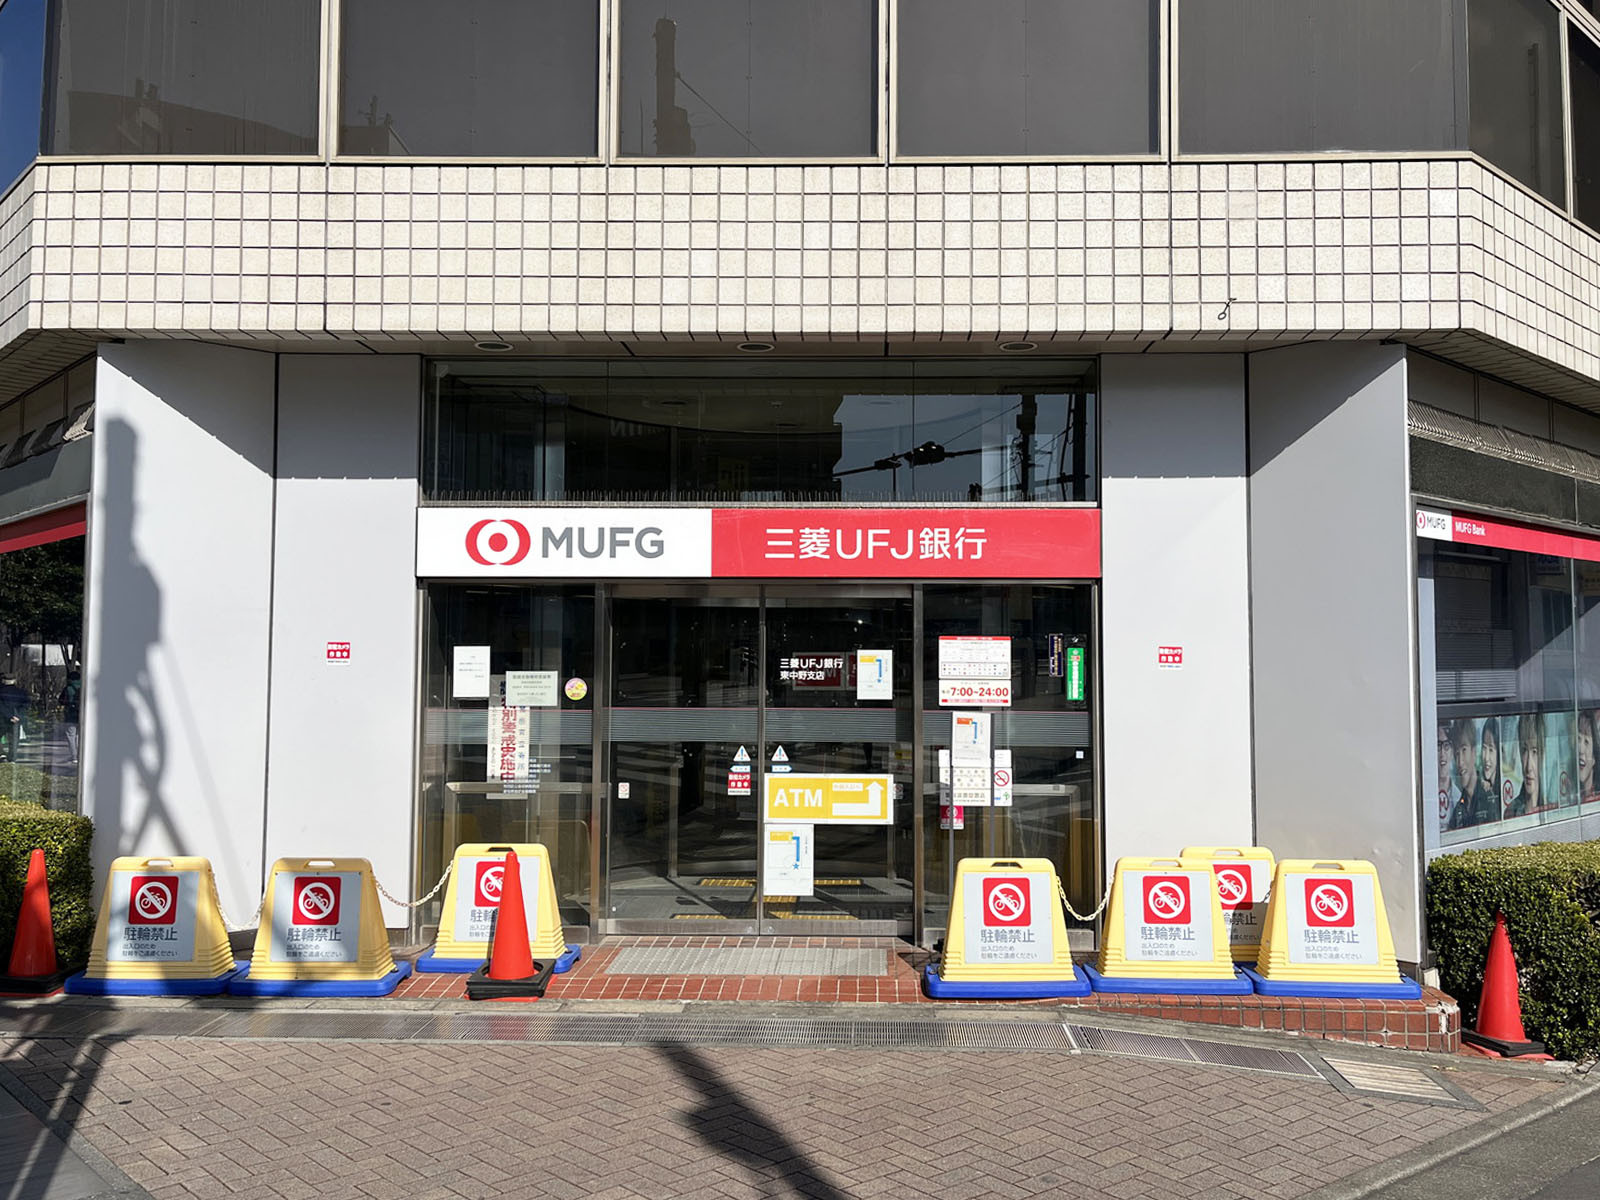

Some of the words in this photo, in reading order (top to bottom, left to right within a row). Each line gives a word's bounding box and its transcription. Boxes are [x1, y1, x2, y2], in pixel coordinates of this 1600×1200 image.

[1426, 515, 1446, 530] MUFG
[1455, 521, 1472, 534] MUFG
[1472, 524, 1486, 536] Bank
[542, 527, 664, 559] MUFG
[765, 527, 987, 560] 三菱UFJ銀行
[780, 658, 843, 669] 三菱UFJ銀行
[780, 670, 825, 681] 東中野支店
[773, 788, 823, 808] ATM
[124, 927, 178, 941] 駐輪禁止
[287, 928, 342, 942] 駐輪禁止
[980, 929, 1035, 943] 駐輪禁止
[1140, 926, 1195, 941] 駐輪禁止
[1304, 929, 1360, 944] 駐輪禁止
